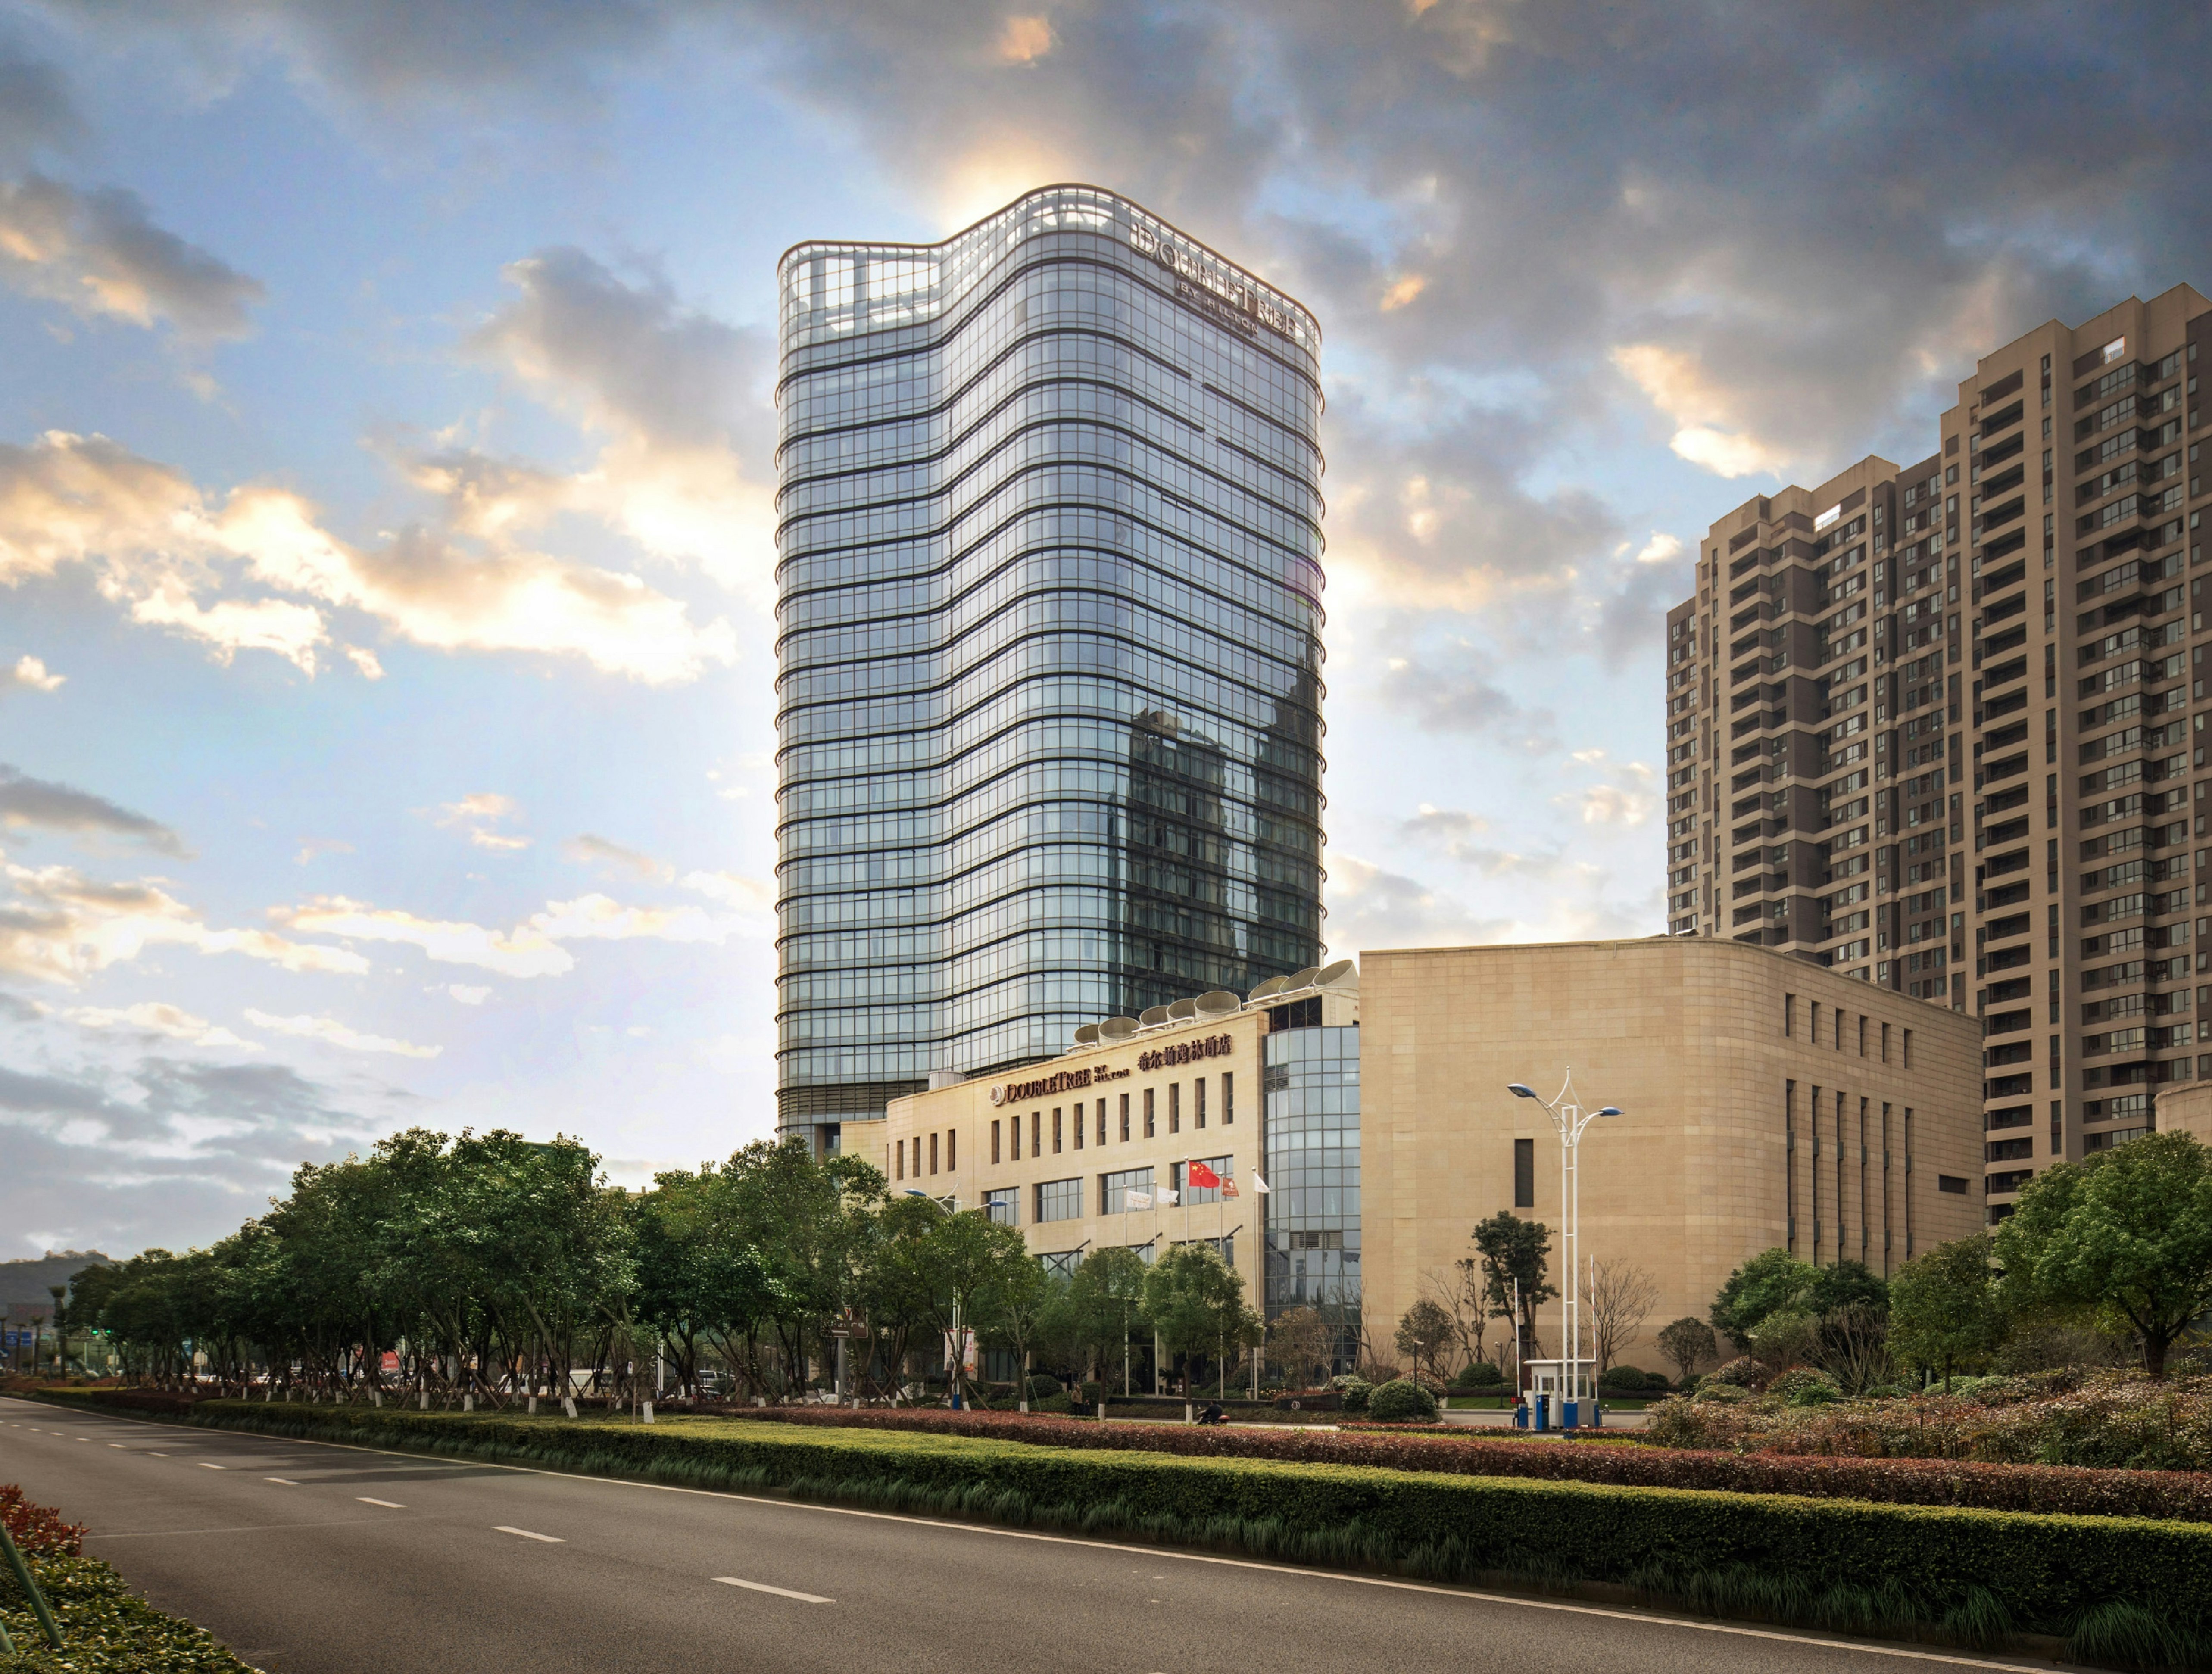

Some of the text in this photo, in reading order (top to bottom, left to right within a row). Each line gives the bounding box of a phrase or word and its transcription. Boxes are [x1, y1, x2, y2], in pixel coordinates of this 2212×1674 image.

[1135, 222, 1296, 340] DOUBLETREE
[1180, 282, 1258, 334] BY HILTON
[1094, 1064, 1107, 1073] BY
[1137, 1033, 1232, 1072] 希尔顿逸林酒店
[1005, 1068, 1091, 1103] DOUBLETREE
[1094, 1068, 1130, 1082] HILTON
